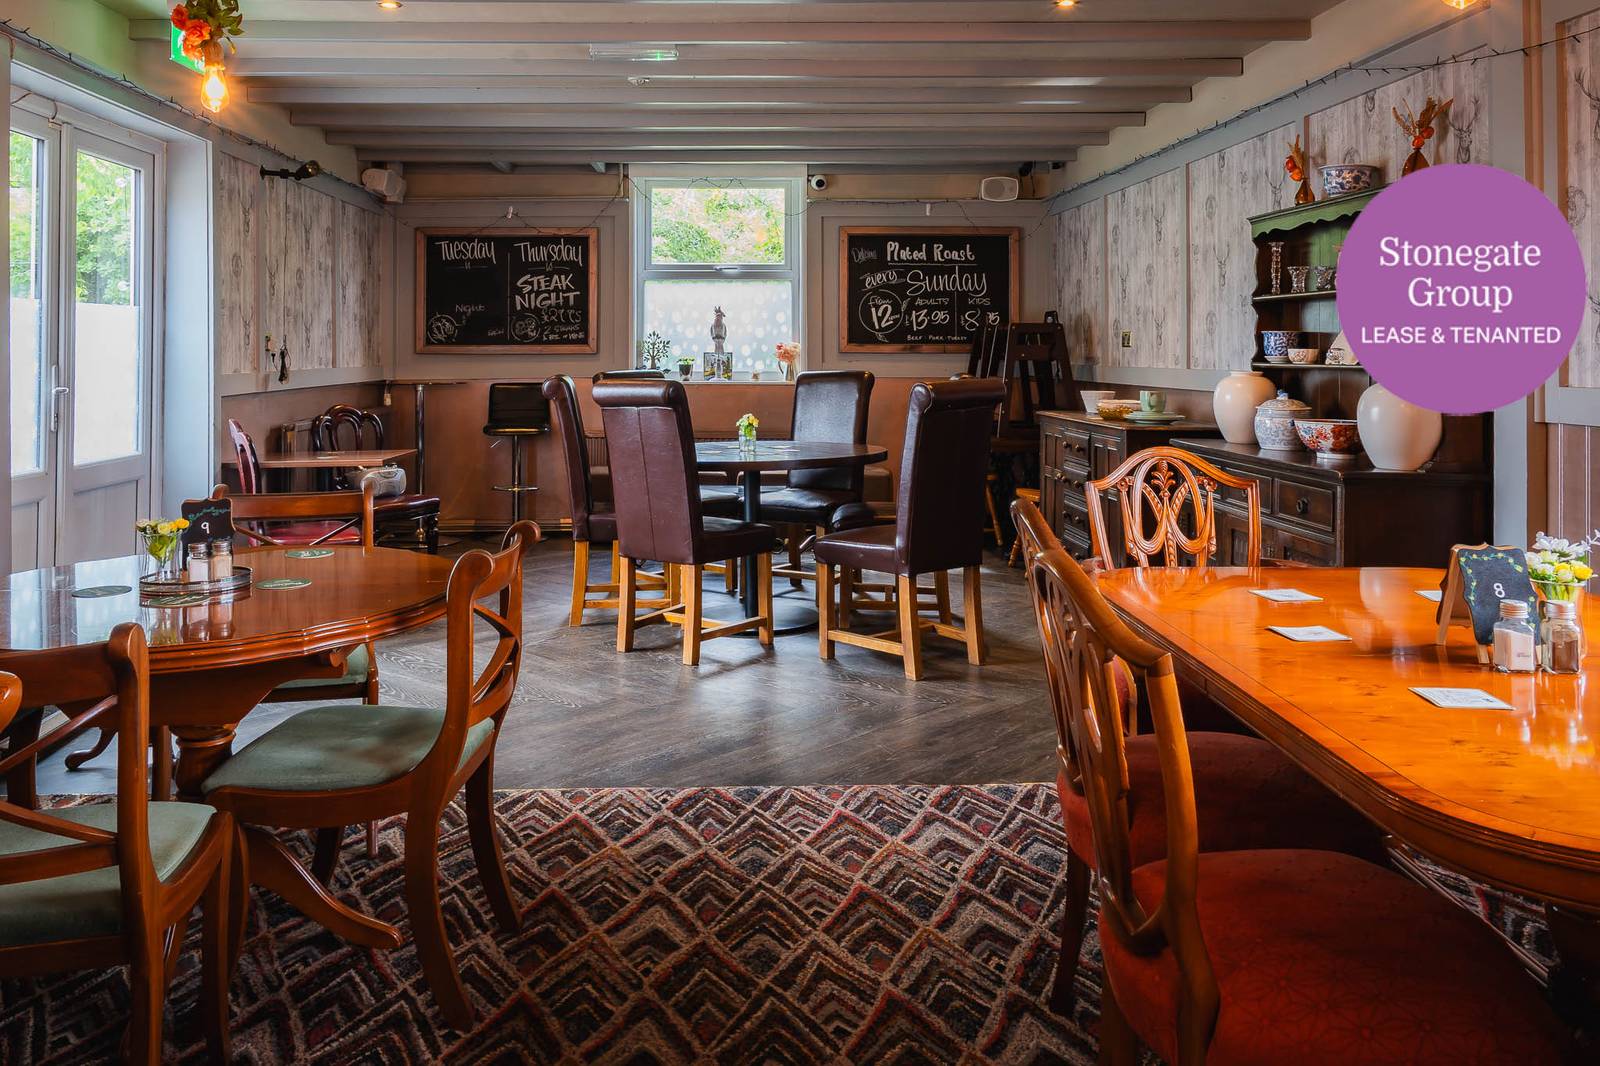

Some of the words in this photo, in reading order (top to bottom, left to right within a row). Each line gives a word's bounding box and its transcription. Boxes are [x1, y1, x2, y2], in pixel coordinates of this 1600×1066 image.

[435, 239, 496, 264] Tuesday
[513, 239, 583, 267] Thursday
[886, 241, 927, 262] Plated
[933, 243, 975, 262] Roast
[516, 273, 575, 294] STEAK
[865, 269, 898, 288] every
[906, 266, 988, 297] Sunday
[515, 291, 580, 311] NIGHT
[915, 297, 950, 306] ADULTS
[968, 298, 991, 306] KIDS
[871, 304, 894, 330] 12
[200, 521, 210, 534] 9
[1493, 582, 1506, 598] 8
